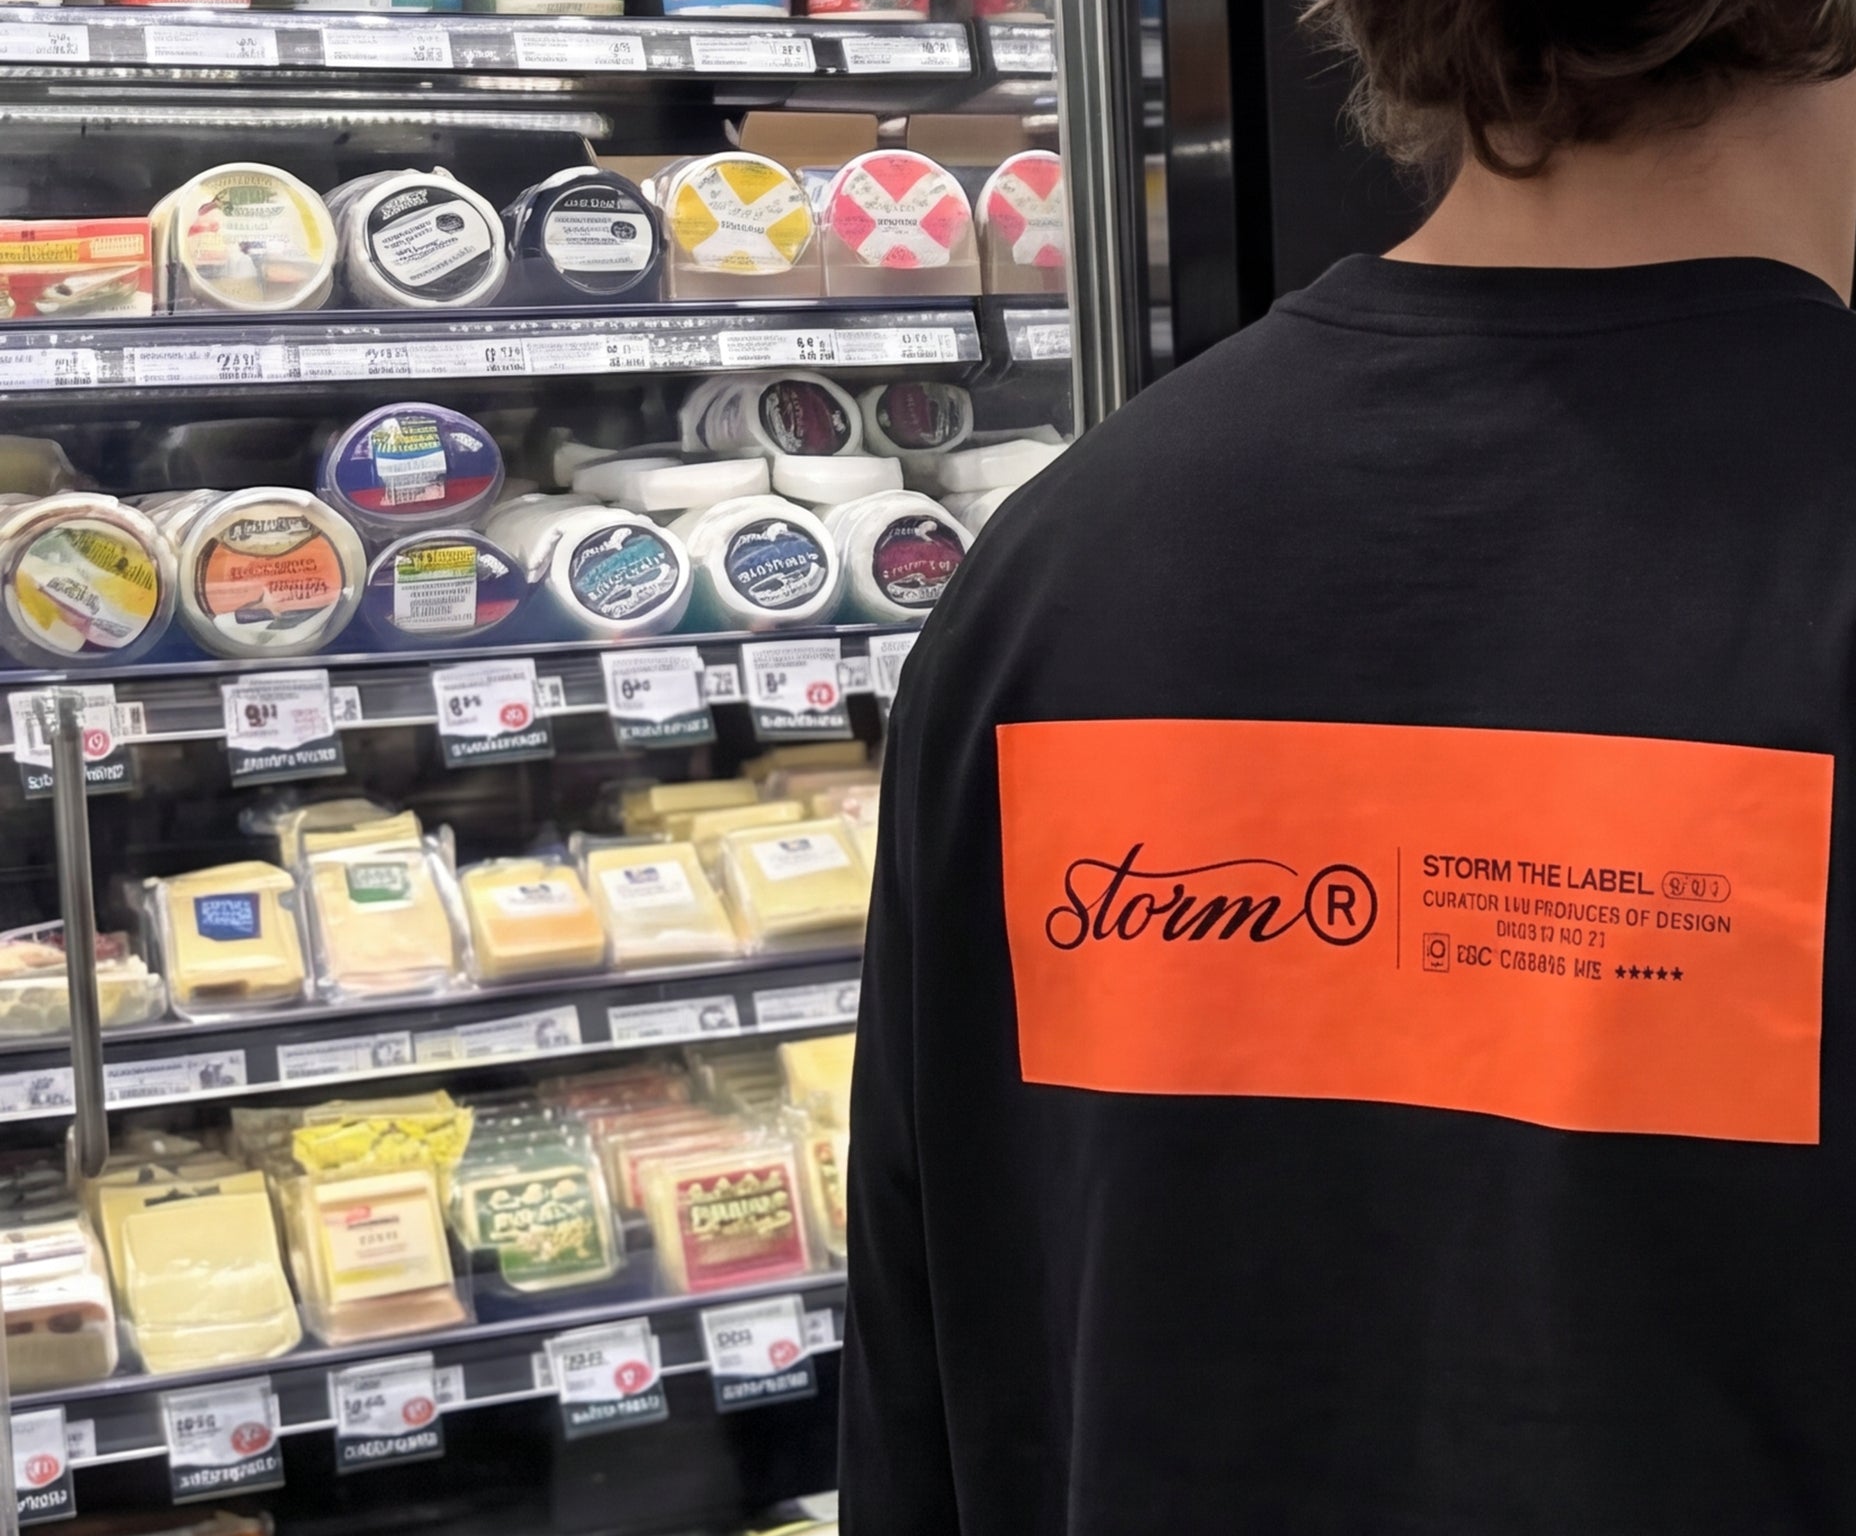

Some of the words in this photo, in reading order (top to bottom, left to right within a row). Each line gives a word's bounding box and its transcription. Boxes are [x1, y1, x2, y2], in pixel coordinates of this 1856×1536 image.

[1423, 854, 1512, 882] STORM
[1517, 861, 1562, 888] THE
[1566, 866, 1655, 896] LABEL
[1422, 890, 1499, 912] CURATOR
[1625, 908, 1651, 927] OF
[1656, 911, 1731, 933] DESIGN
